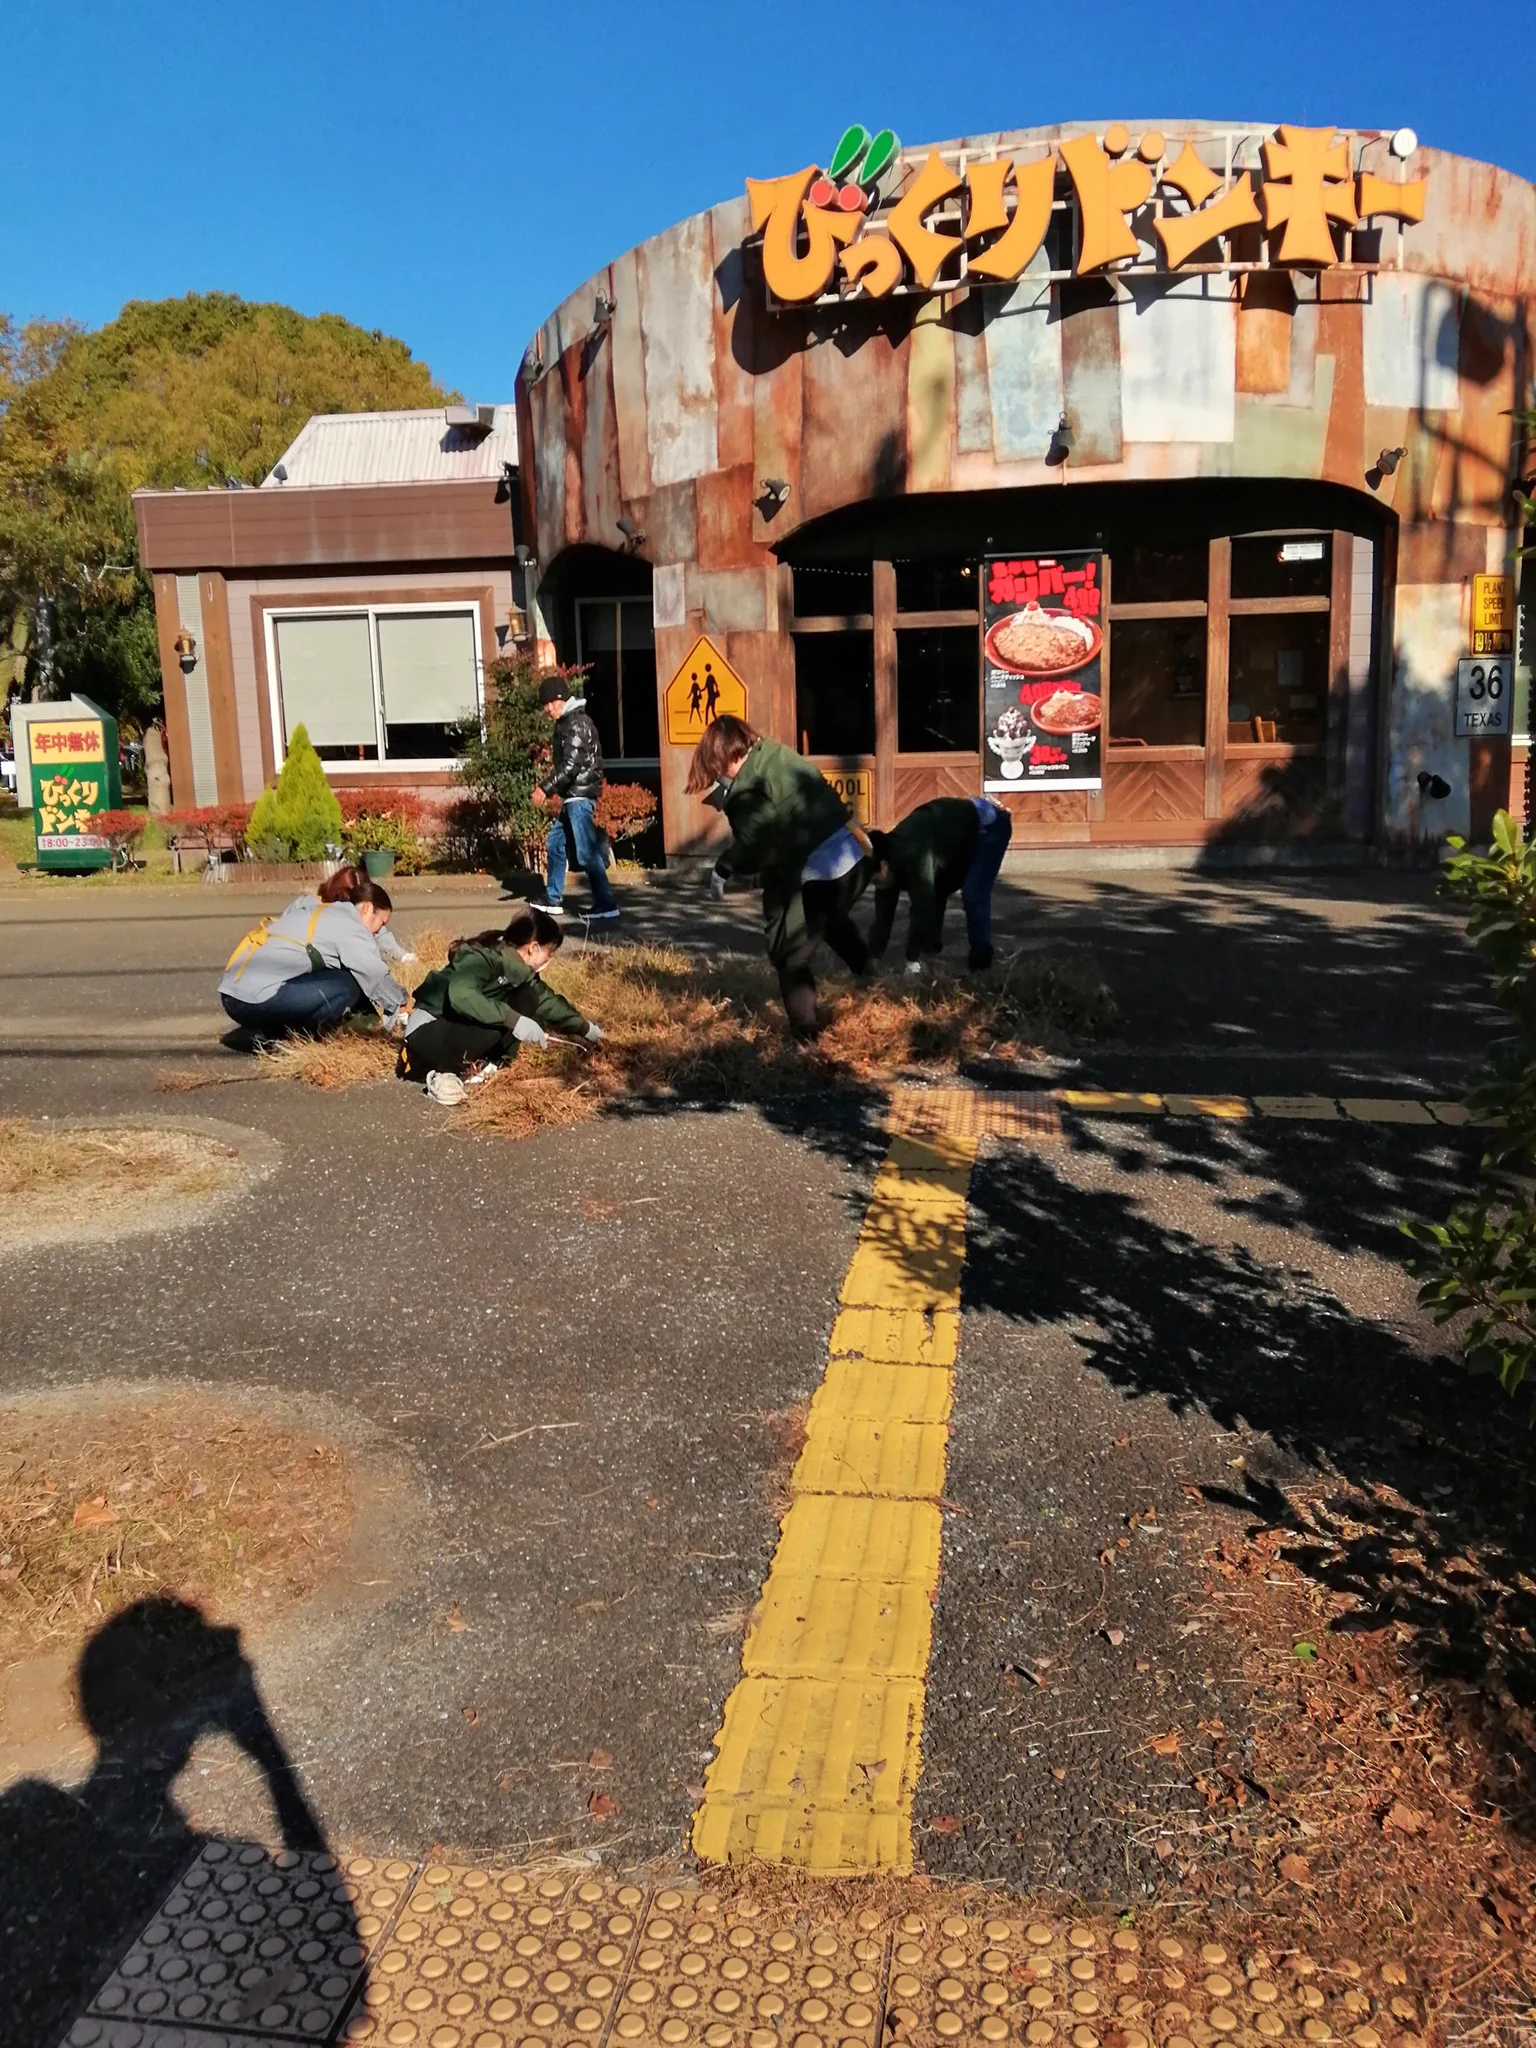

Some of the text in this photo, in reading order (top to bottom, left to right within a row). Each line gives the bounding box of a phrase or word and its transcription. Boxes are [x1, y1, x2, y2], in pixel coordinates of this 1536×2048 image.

[746, 124, 1427, 300] びっくりドンキー
[1483, 582, 1506, 594] PLANT
[1483, 598, 1506, 610] SPEED
[1484, 613, 1504, 625] LIMIT
[1469, 665, 1503, 700] 36
[1464, 712, 1503, 728] TEXAS
[35, 731, 100, 753] 年中無休
[39, 778, 99, 807] びっくり
[38, 805, 91, 834] ドンキ
